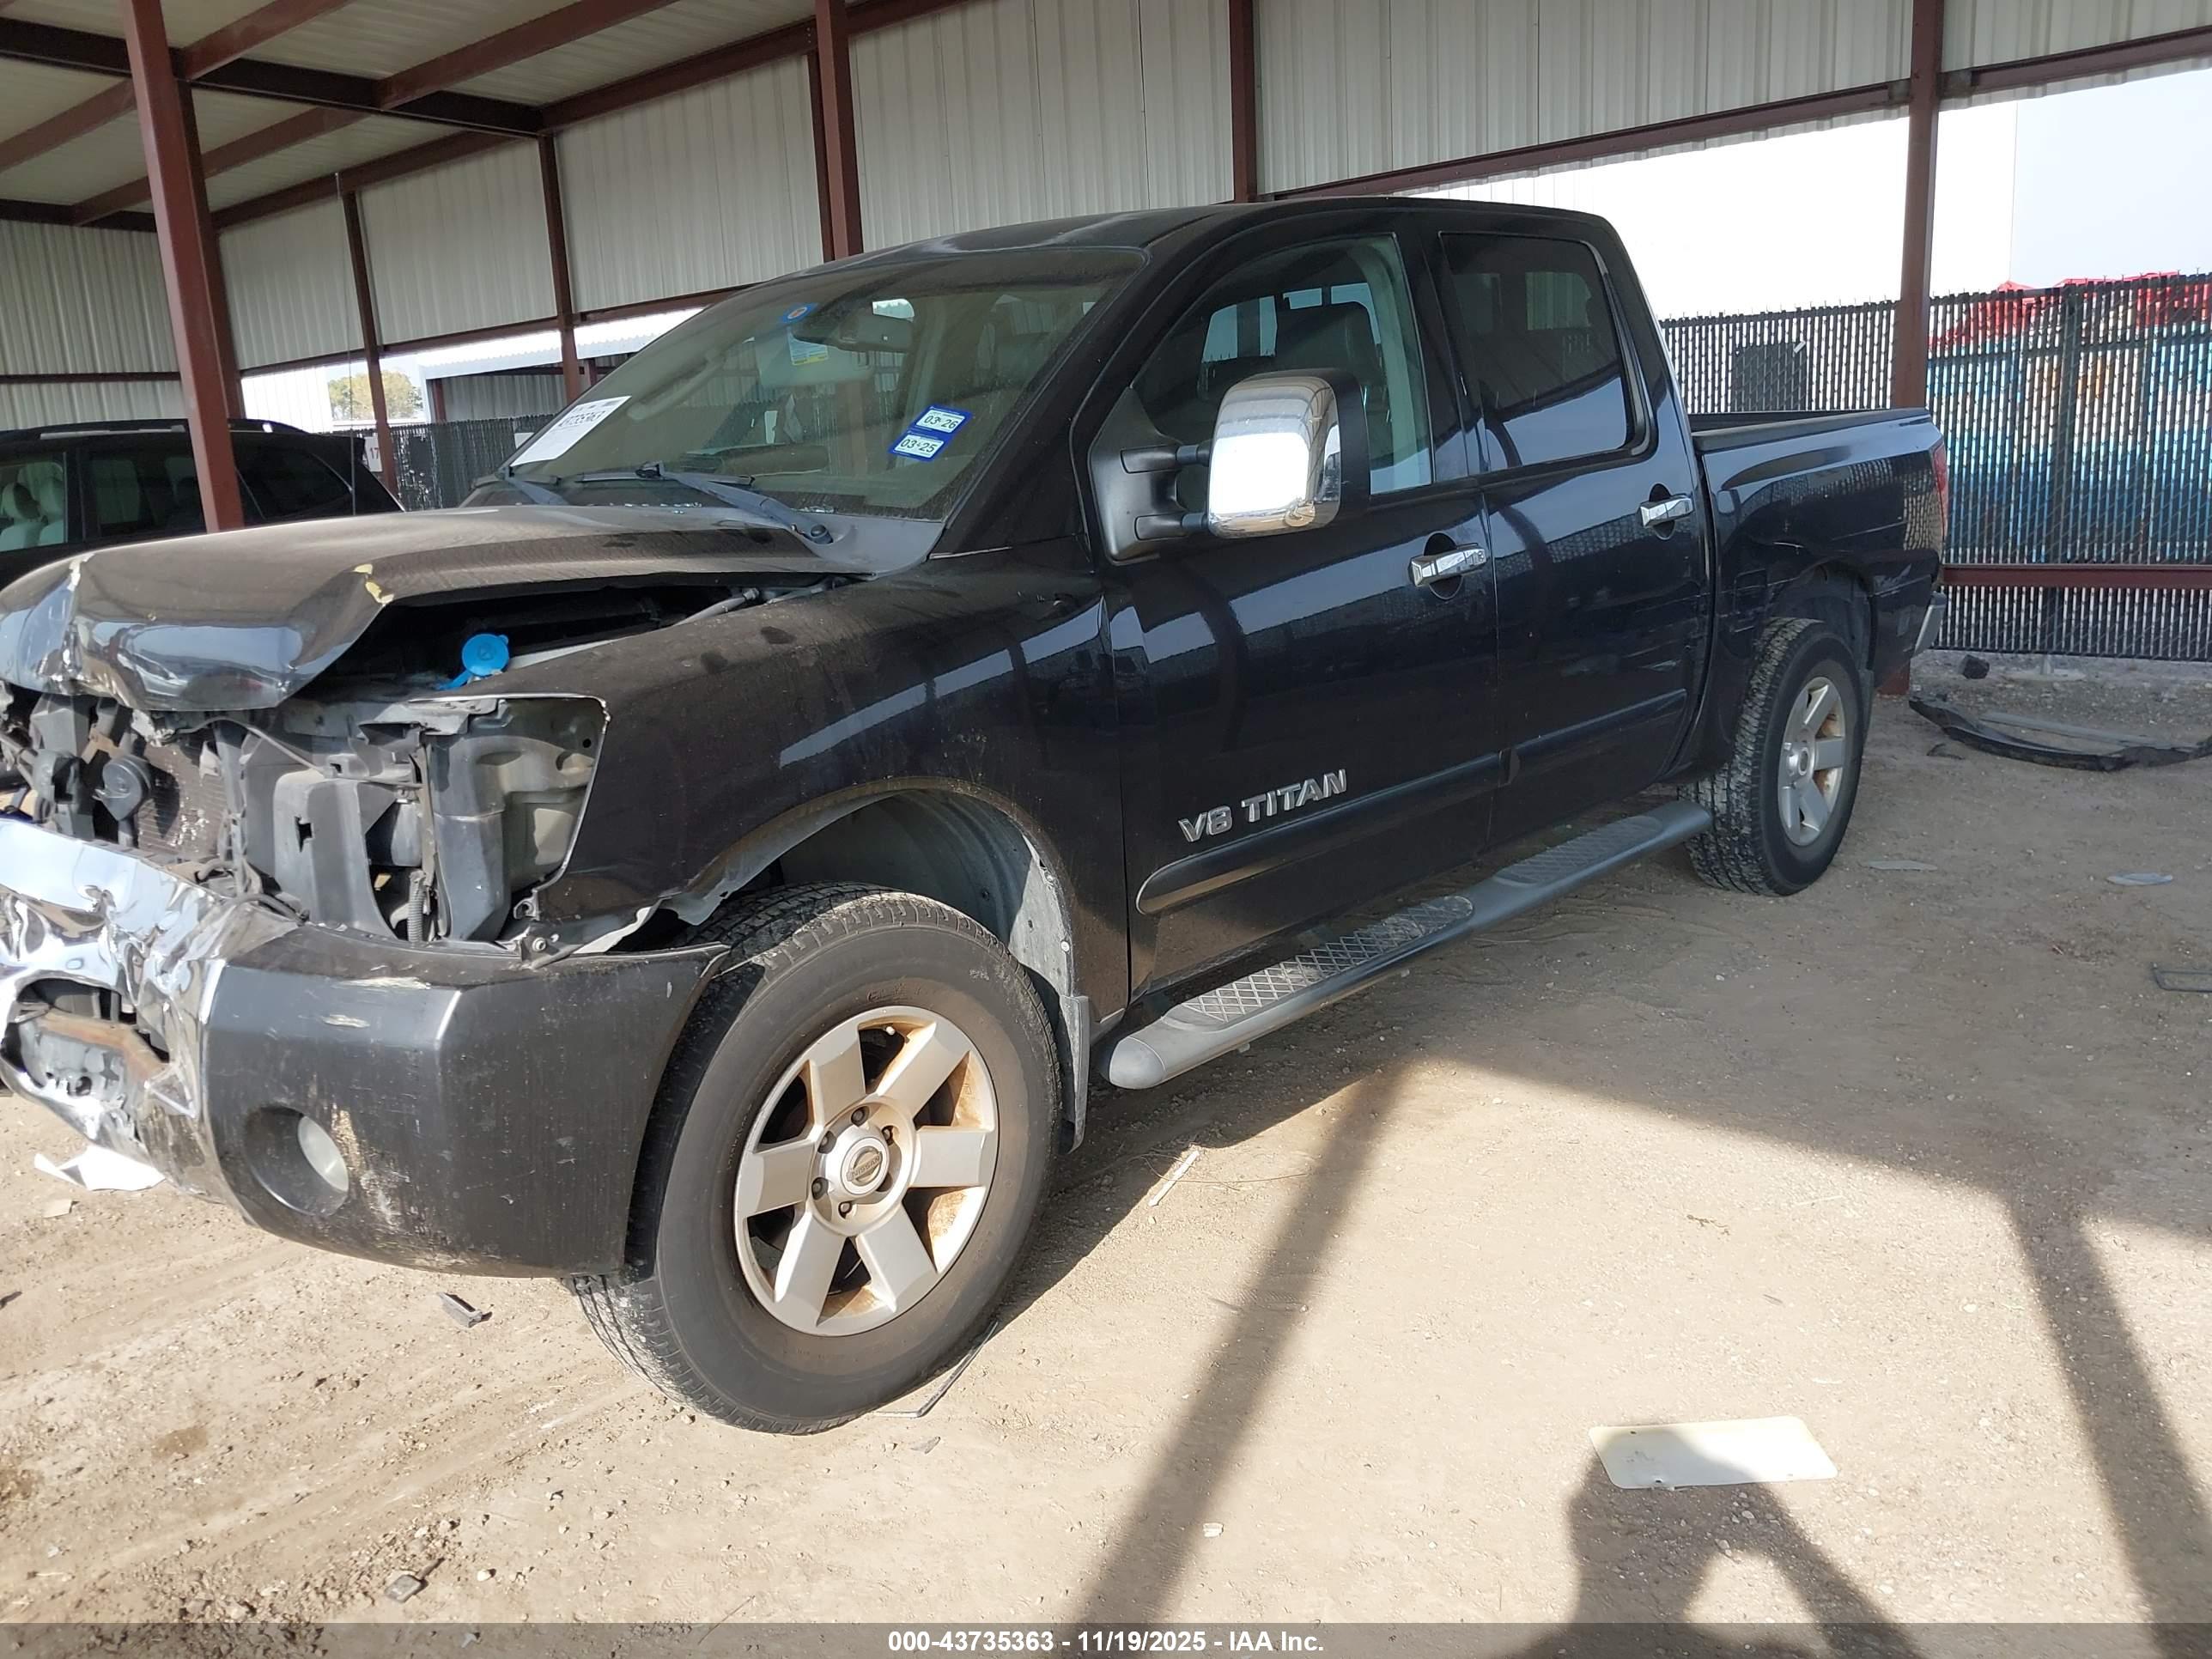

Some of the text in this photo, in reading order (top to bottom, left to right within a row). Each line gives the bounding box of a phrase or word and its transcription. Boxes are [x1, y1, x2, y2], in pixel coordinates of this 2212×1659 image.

[1178, 769, 1347, 842] V8 TITAN
[850, 1157, 881, 1177] NISSAN
